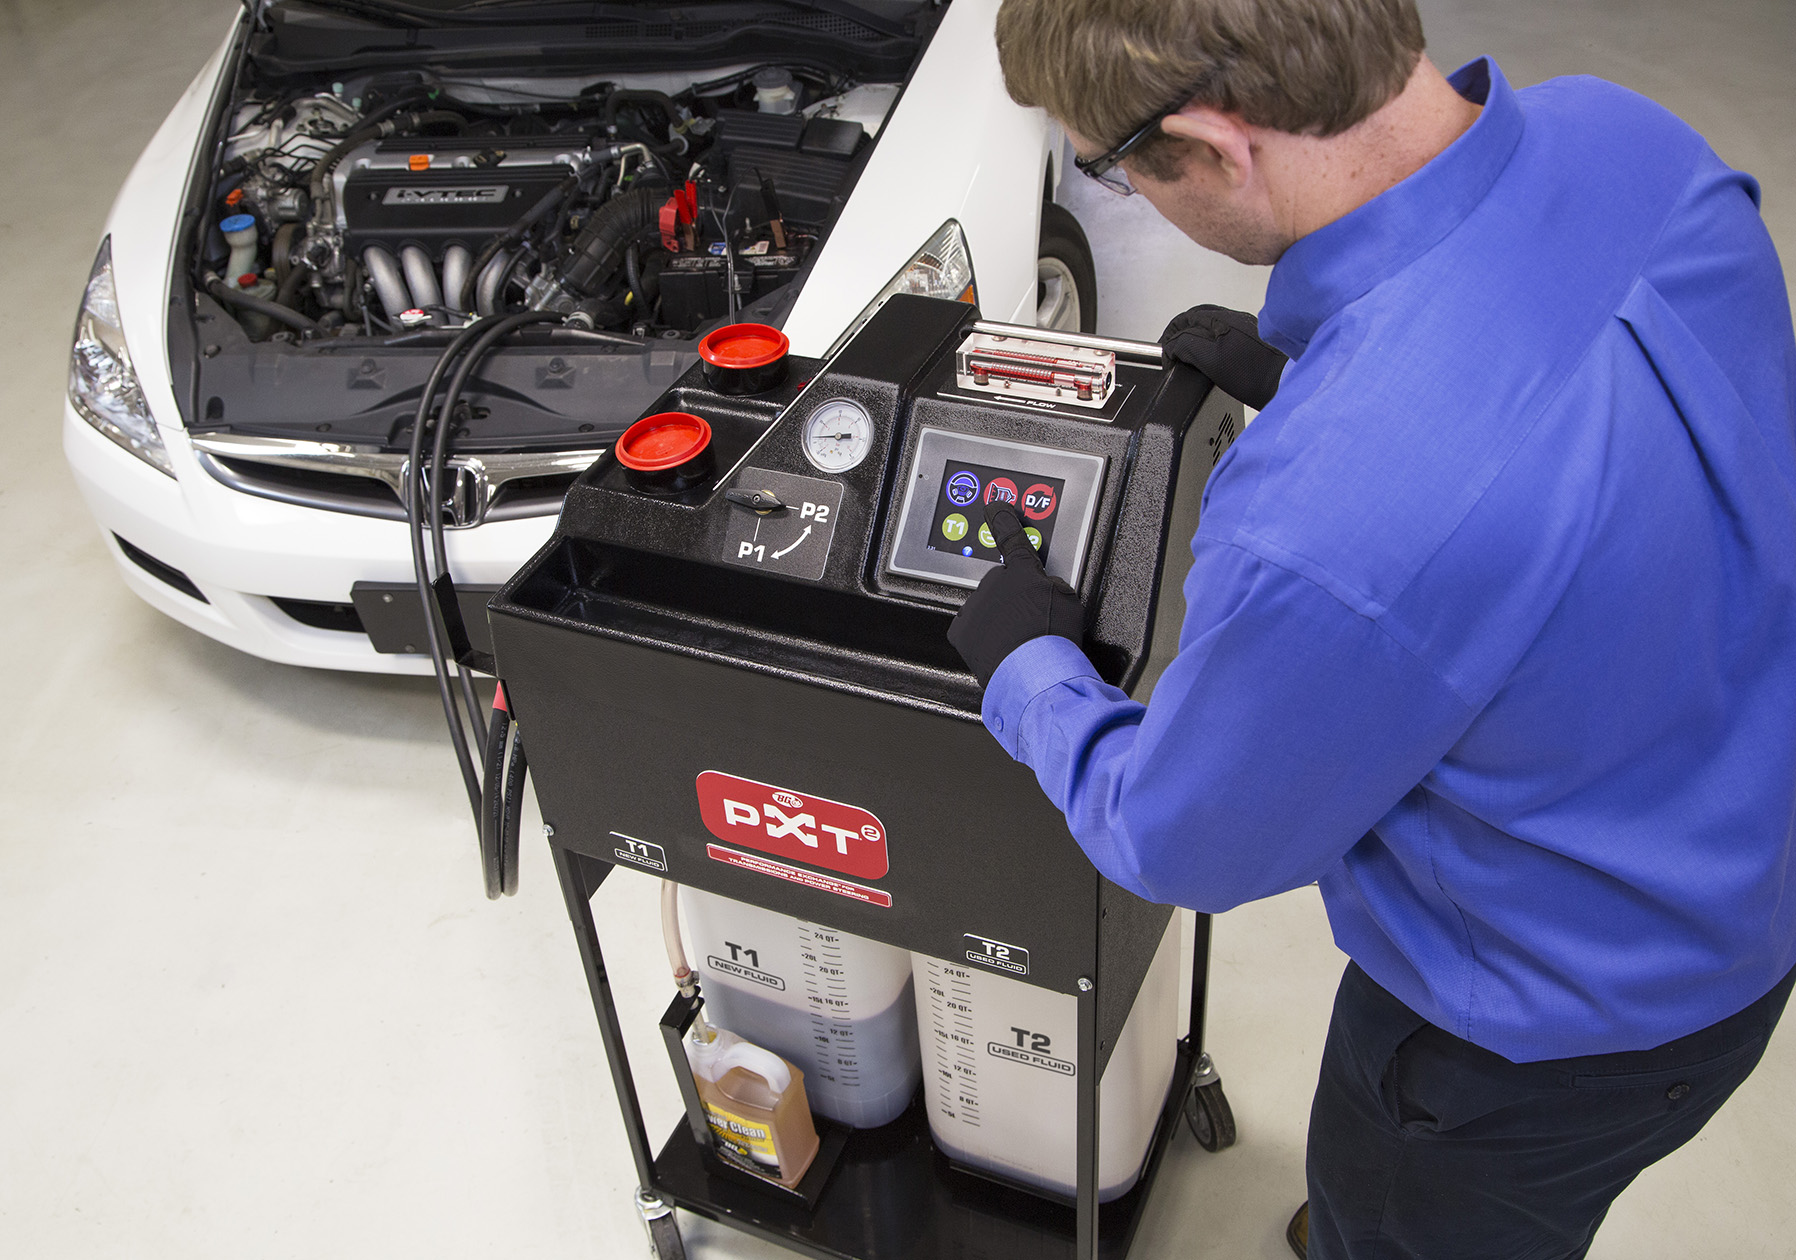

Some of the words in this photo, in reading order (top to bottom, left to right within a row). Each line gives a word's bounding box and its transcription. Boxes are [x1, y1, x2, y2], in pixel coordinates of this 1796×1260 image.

[1026, 400, 1056, 409] FLOW
[800, 501, 830, 523] P2
[1025, 494, 1051, 509] D/F
[946, 519, 966, 535] T1
[738, 541, 765, 562] P1
[625, 839, 648, 857] T1
[619, 851, 637, 861] NEW
[637, 857, 660, 868] FLUID
[728, 857, 789, 878] TRANSMISSIONS
[804, 878, 831, 890] POWER
[832, 886, 869, 900] STEERING
[740, 856, 796, 876] PERFORMANCE
[841, 884, 855, 892] FOR
[725, 941, 759, 968] T1
[982, 941, 1010, 961] T2
[714, 960, 742, 975] NEW
[744, 969, 778, 986] FLUID
[943, 967, 954, 975] 24
[969, 953, 995, 964] USED
[996, 961, 1023, 972] FLUID
[1010, 1026, 1051, 1054] T2
[992, 1046, 1029, 1062] USED
[1032, 1054, 1071, 1072] FLUID
[708, 1114, 728, 1129] wer
[729, 1121, 765, 1139] Clean
